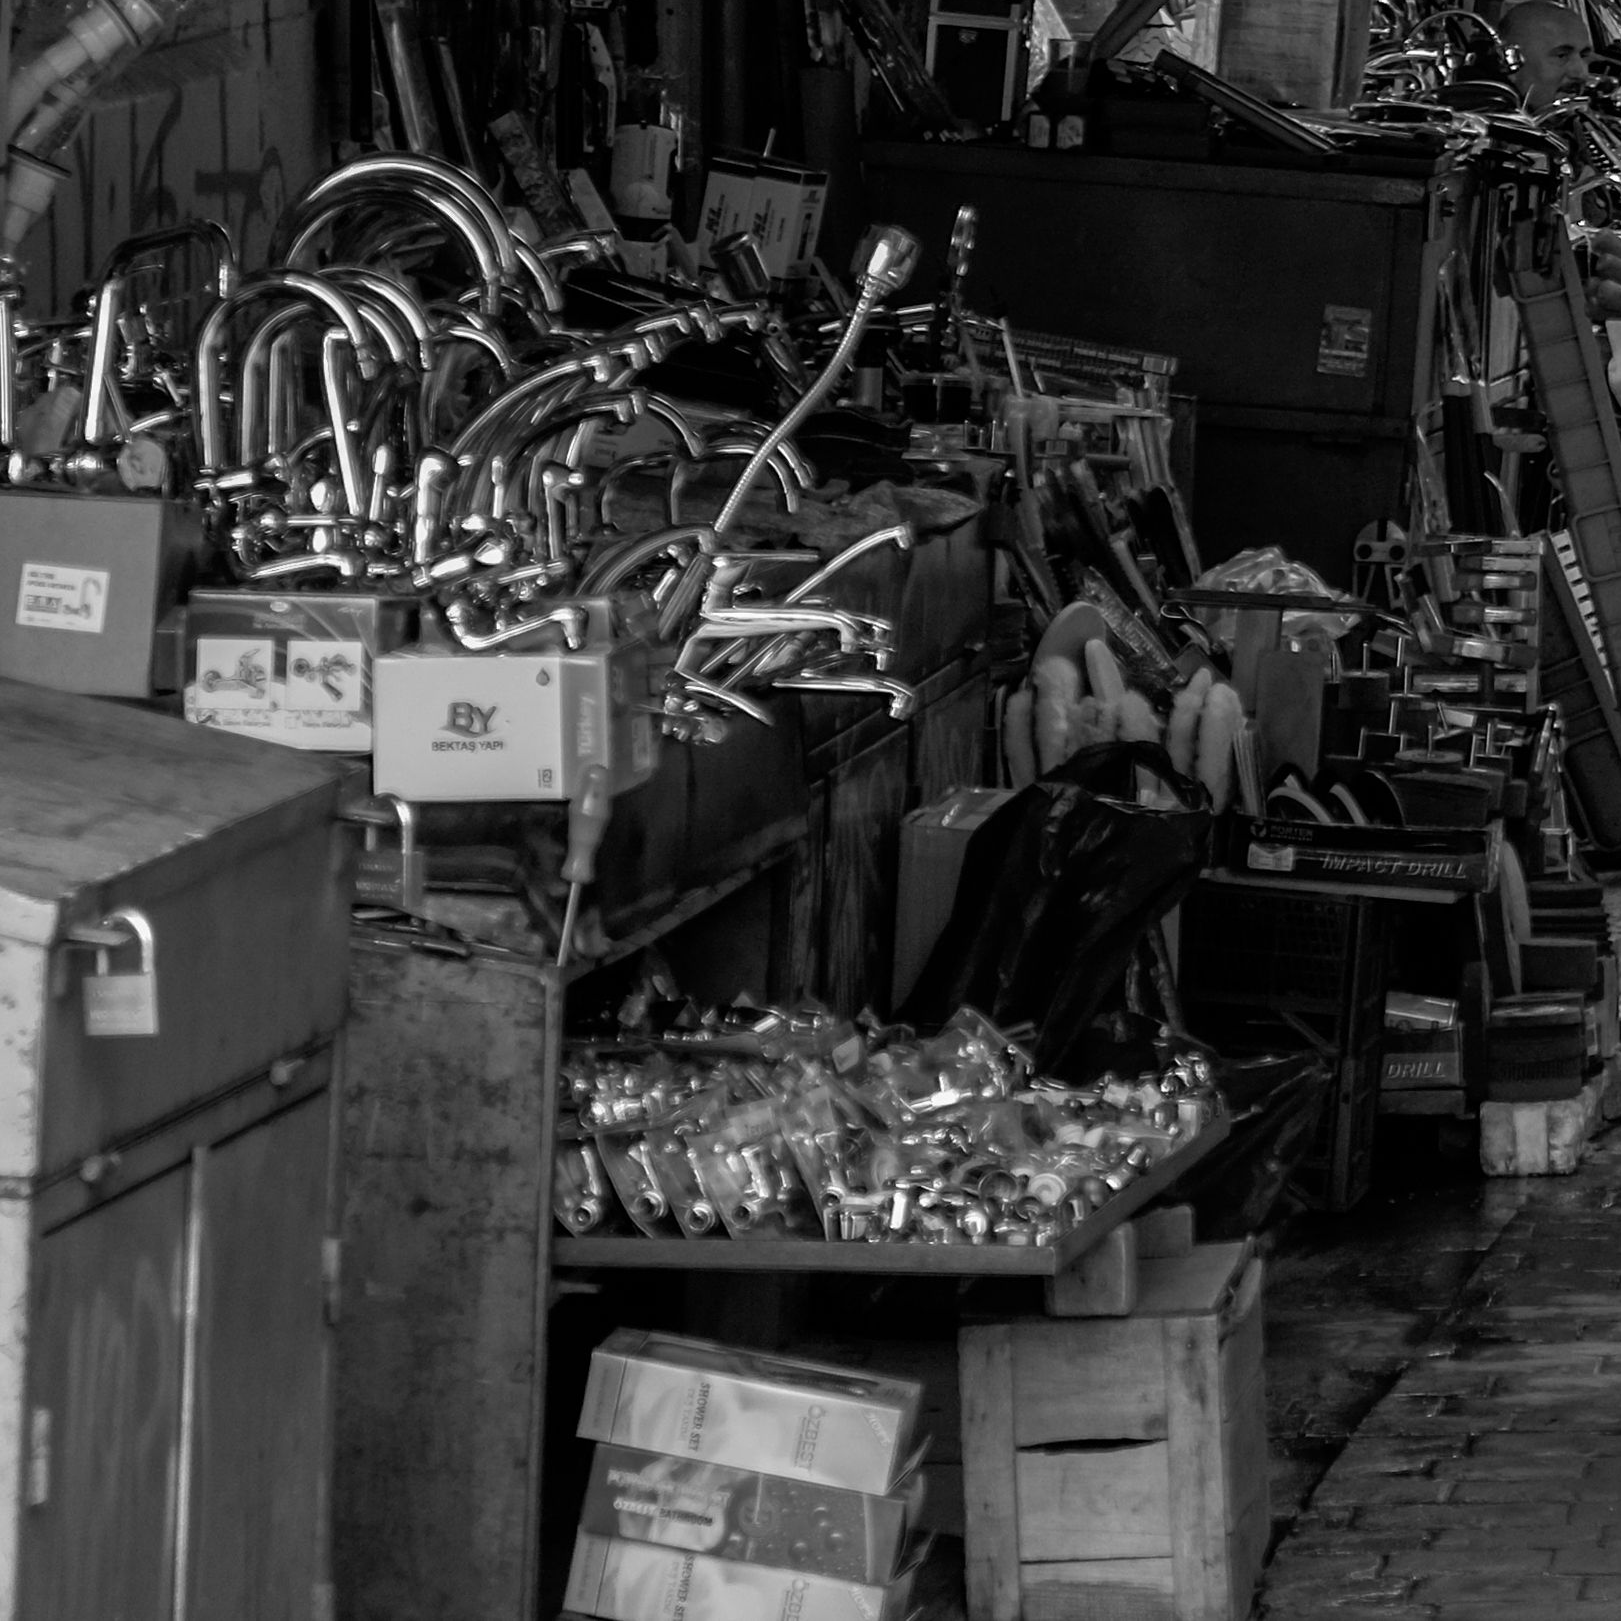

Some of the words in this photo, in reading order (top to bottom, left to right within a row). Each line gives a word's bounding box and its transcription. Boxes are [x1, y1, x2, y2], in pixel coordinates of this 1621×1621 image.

[431, 740, 476, 753] BEKTAŞ
[478, 740, 504, 751] YAPI
[1321, 853, 1403, 875] IMPACT
[1406, 861, 1467, 880] DRILL
[1386, 1061, 1447, 1080] DRILL
[696, 1381, 712, 1438] SHOWER
[688, 1436, 702, 1453] SET
[800, 1403, 828, 1472] ÖZBEST
